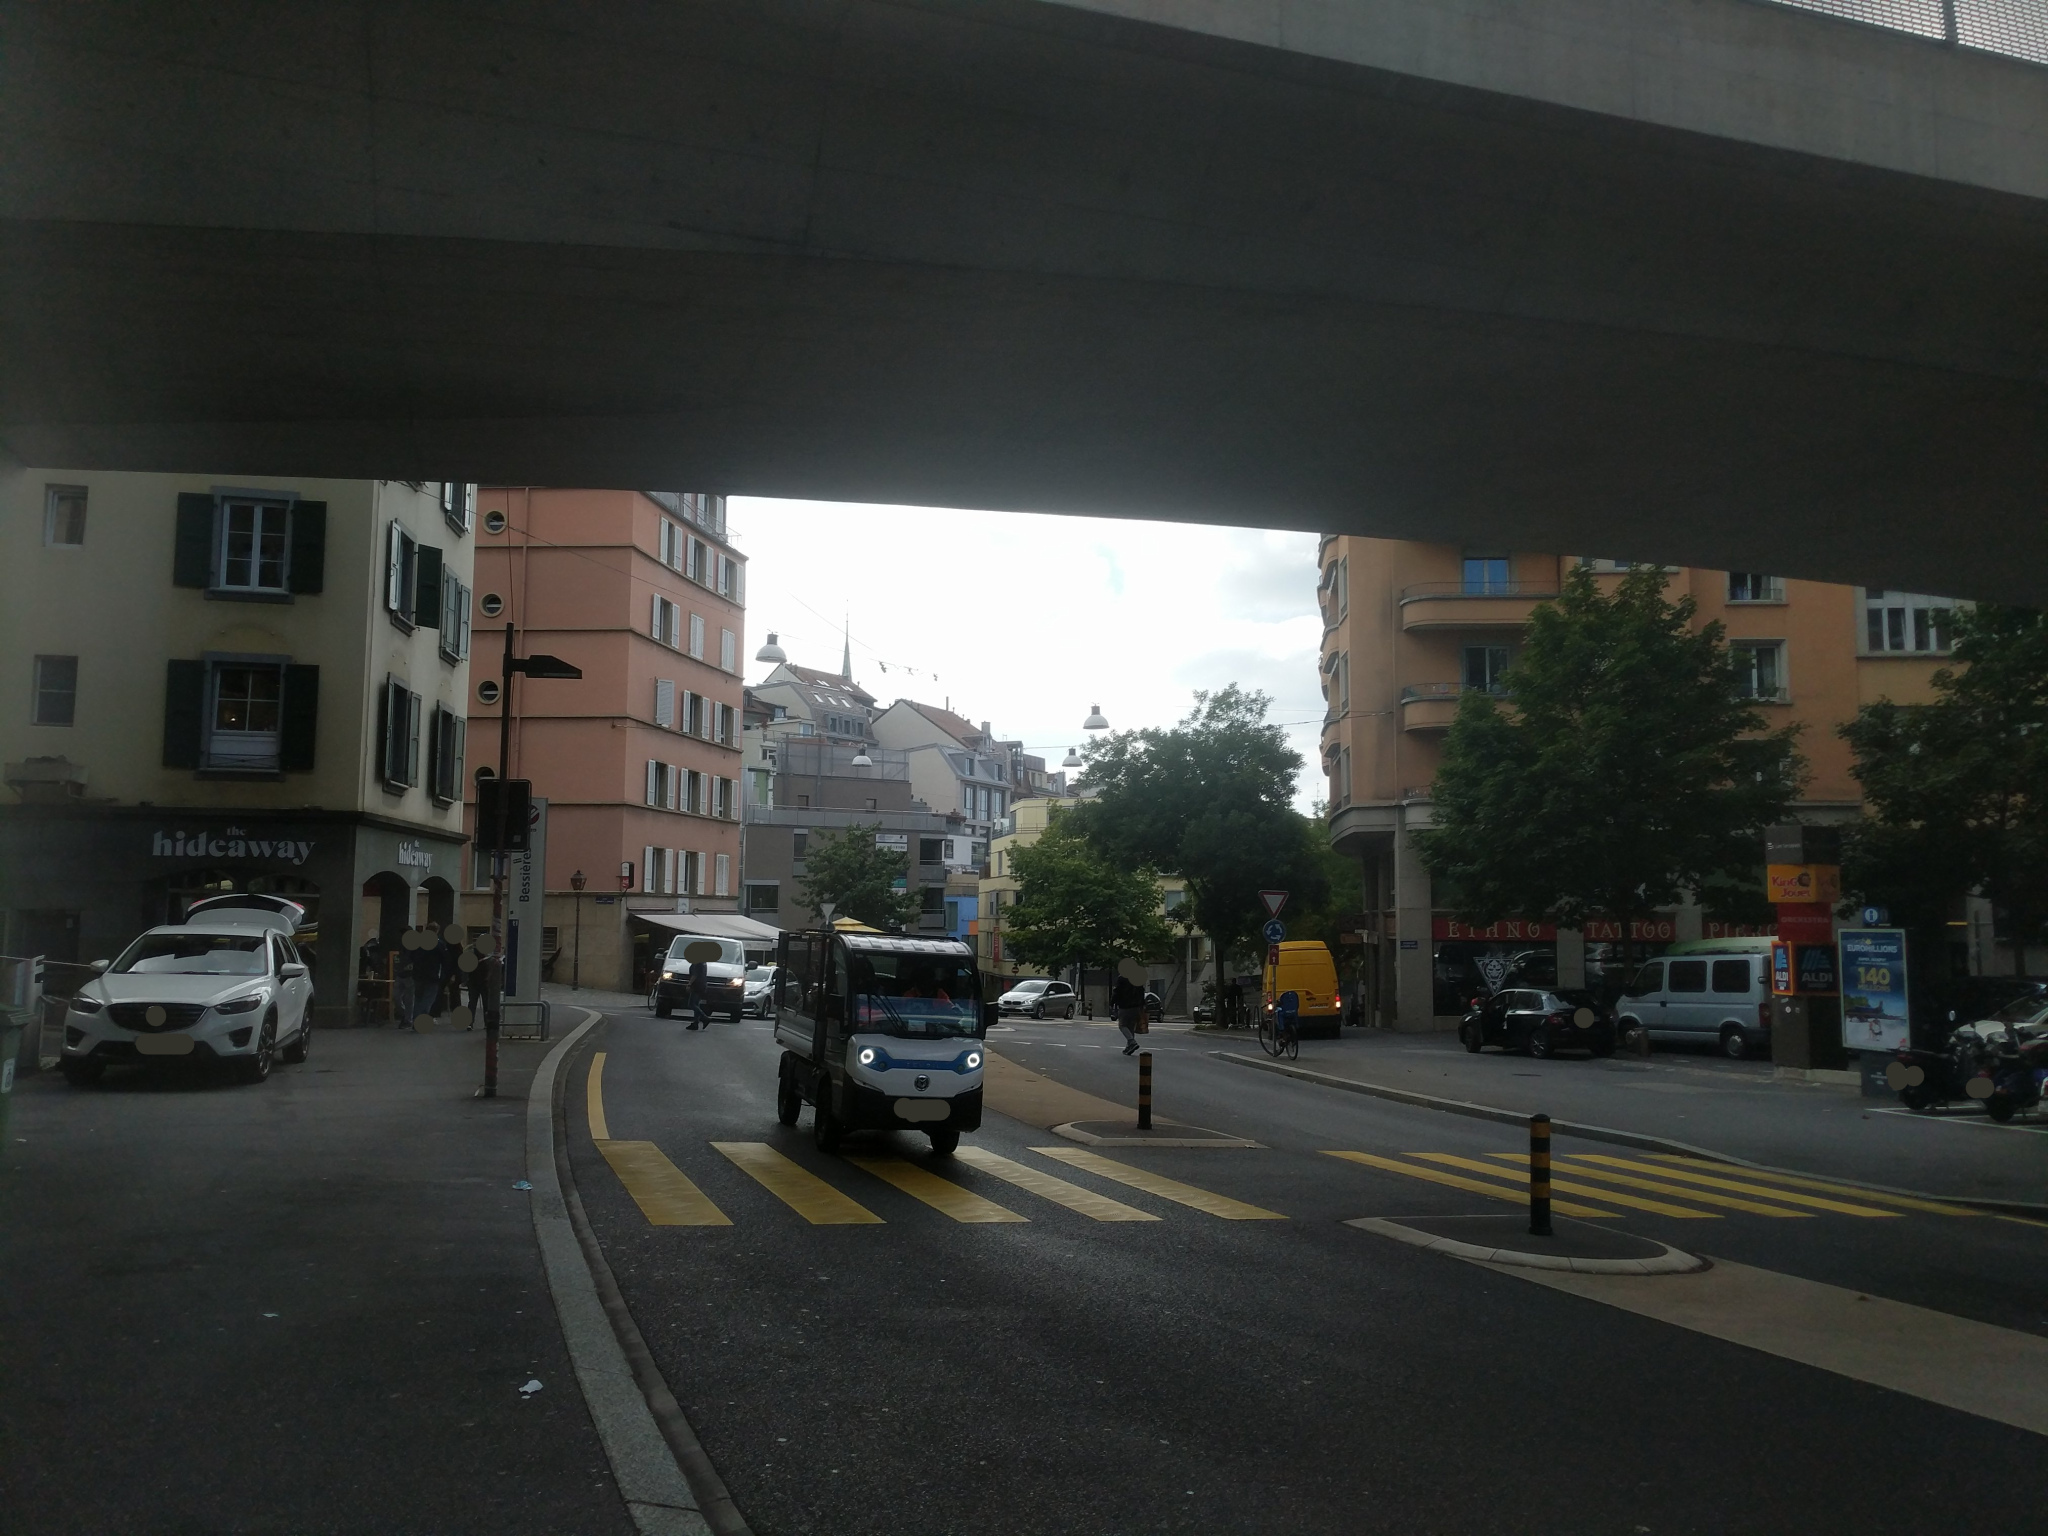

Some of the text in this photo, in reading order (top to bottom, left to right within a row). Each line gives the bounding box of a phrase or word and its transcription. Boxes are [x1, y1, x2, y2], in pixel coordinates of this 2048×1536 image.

[226, 825, 247, 836] the
[151, 830, 316, 866] hideaway
[397, 841, 433, 874] hideaway
[1586, 921, 1671, 939] TATTOO
[1847, 944, 1898, 954] EUROMILLIONS
[1775, 970, 1789, 982] ALDI
[1801, 972, 1833, 982] ALDI
[1857, 966, 1891, 986] 140
